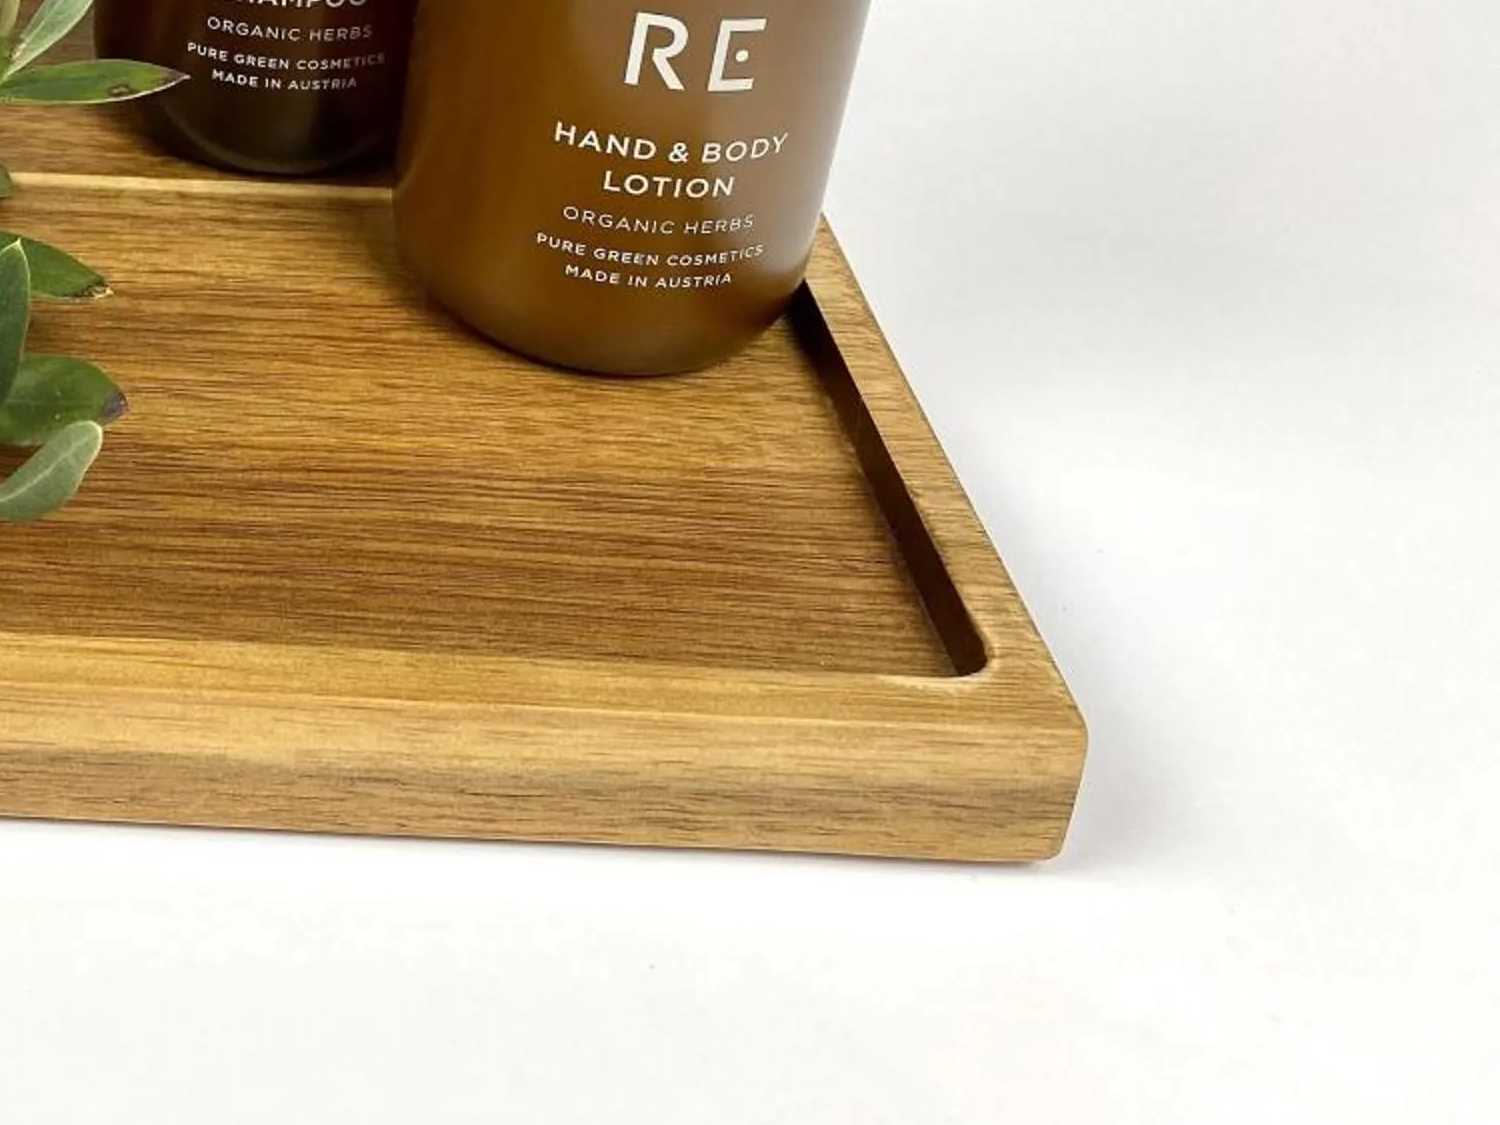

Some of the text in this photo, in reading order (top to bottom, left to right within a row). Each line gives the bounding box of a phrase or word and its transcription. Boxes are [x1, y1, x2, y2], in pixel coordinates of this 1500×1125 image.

[207, 16, 373, 42] ORGANIC HERBS
[187, 42, 385, 70] PURE GREEN COSMETICS
[624, 12, 767, 92] RE
[212, 69, 357, 90] MADE IN AUSTRIA
[554, 121, 789, 163] HAND & BODY
[603, 171, 735, 198] LOTION
[563, 206, 754, 235] ORGANIC HERBS
[537, 232, 764, 267] PURE GREEN COSMETICS
[565, 264, 732, 289] MADE IN AUSTRIA
